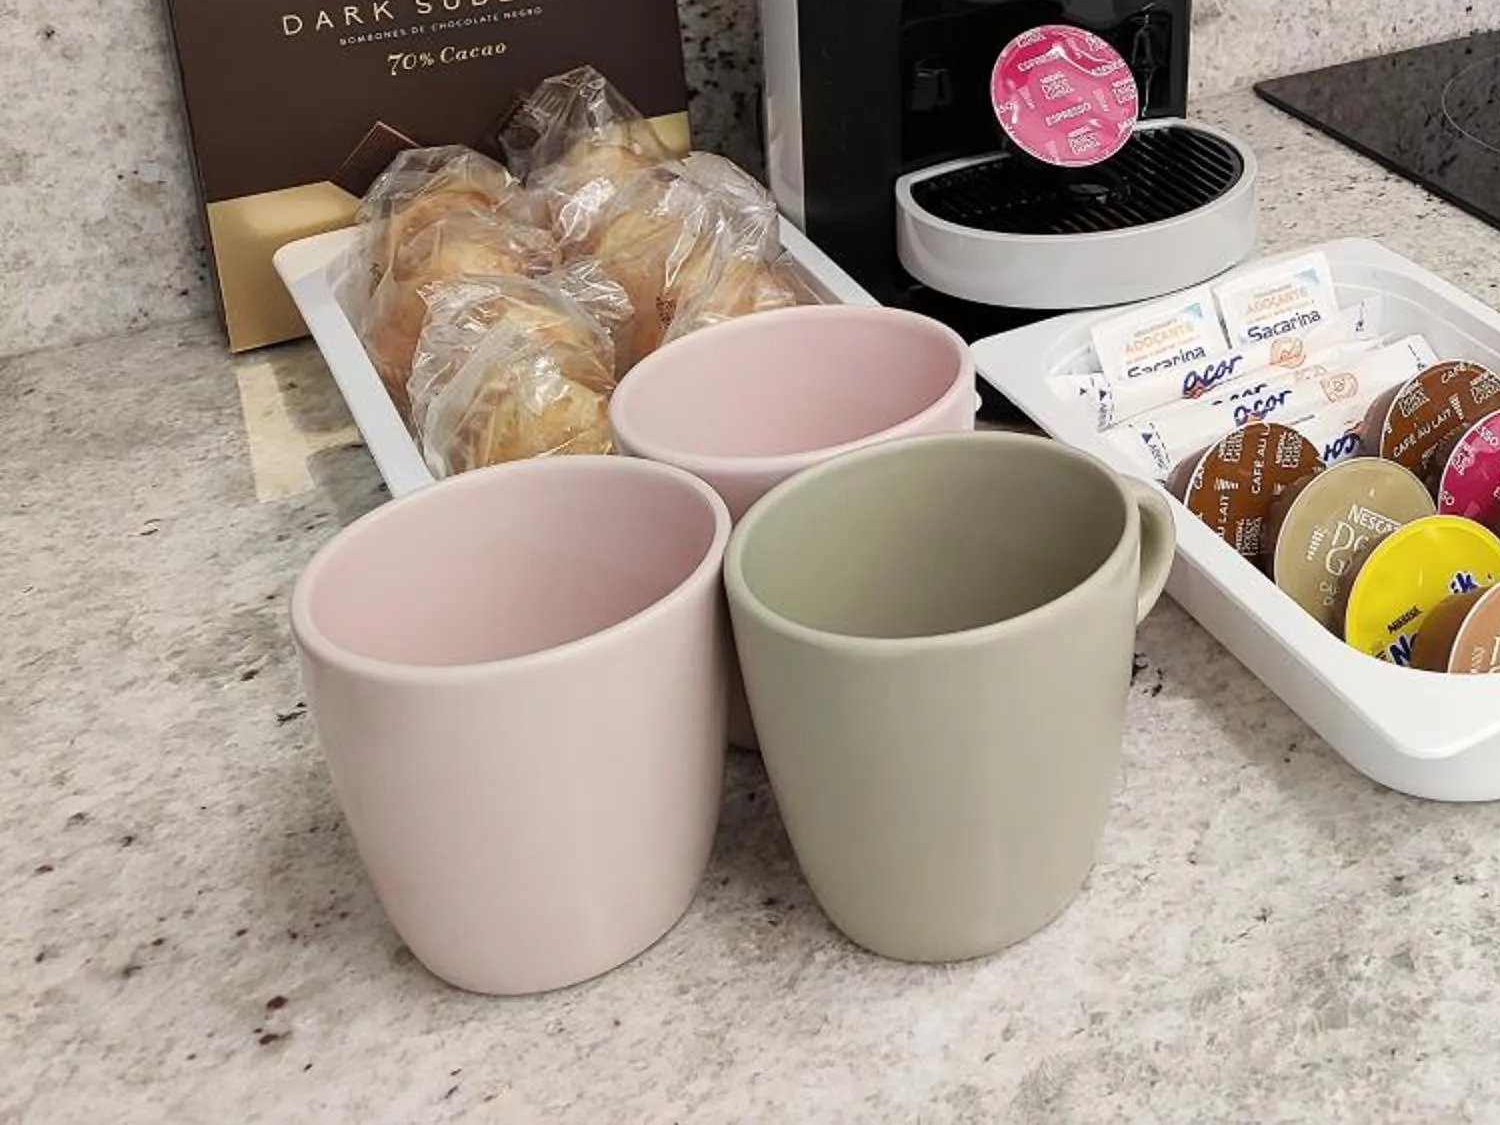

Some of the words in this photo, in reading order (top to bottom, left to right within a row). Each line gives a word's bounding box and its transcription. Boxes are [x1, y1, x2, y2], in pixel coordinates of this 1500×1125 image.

[282, 0, 394, 36] DARK
[340, 27, 408, 46] BOMBONES
[411, 25, 426, 35] DE
[430, 14, 500, 33] CHOCOLATE
[502, 6, 543, 20] NEGRO
[387, 51, 435, 76] 70%
[439, 41, 508, 64] Cacao
[1247, 309, 1322, 343] Sacarina
